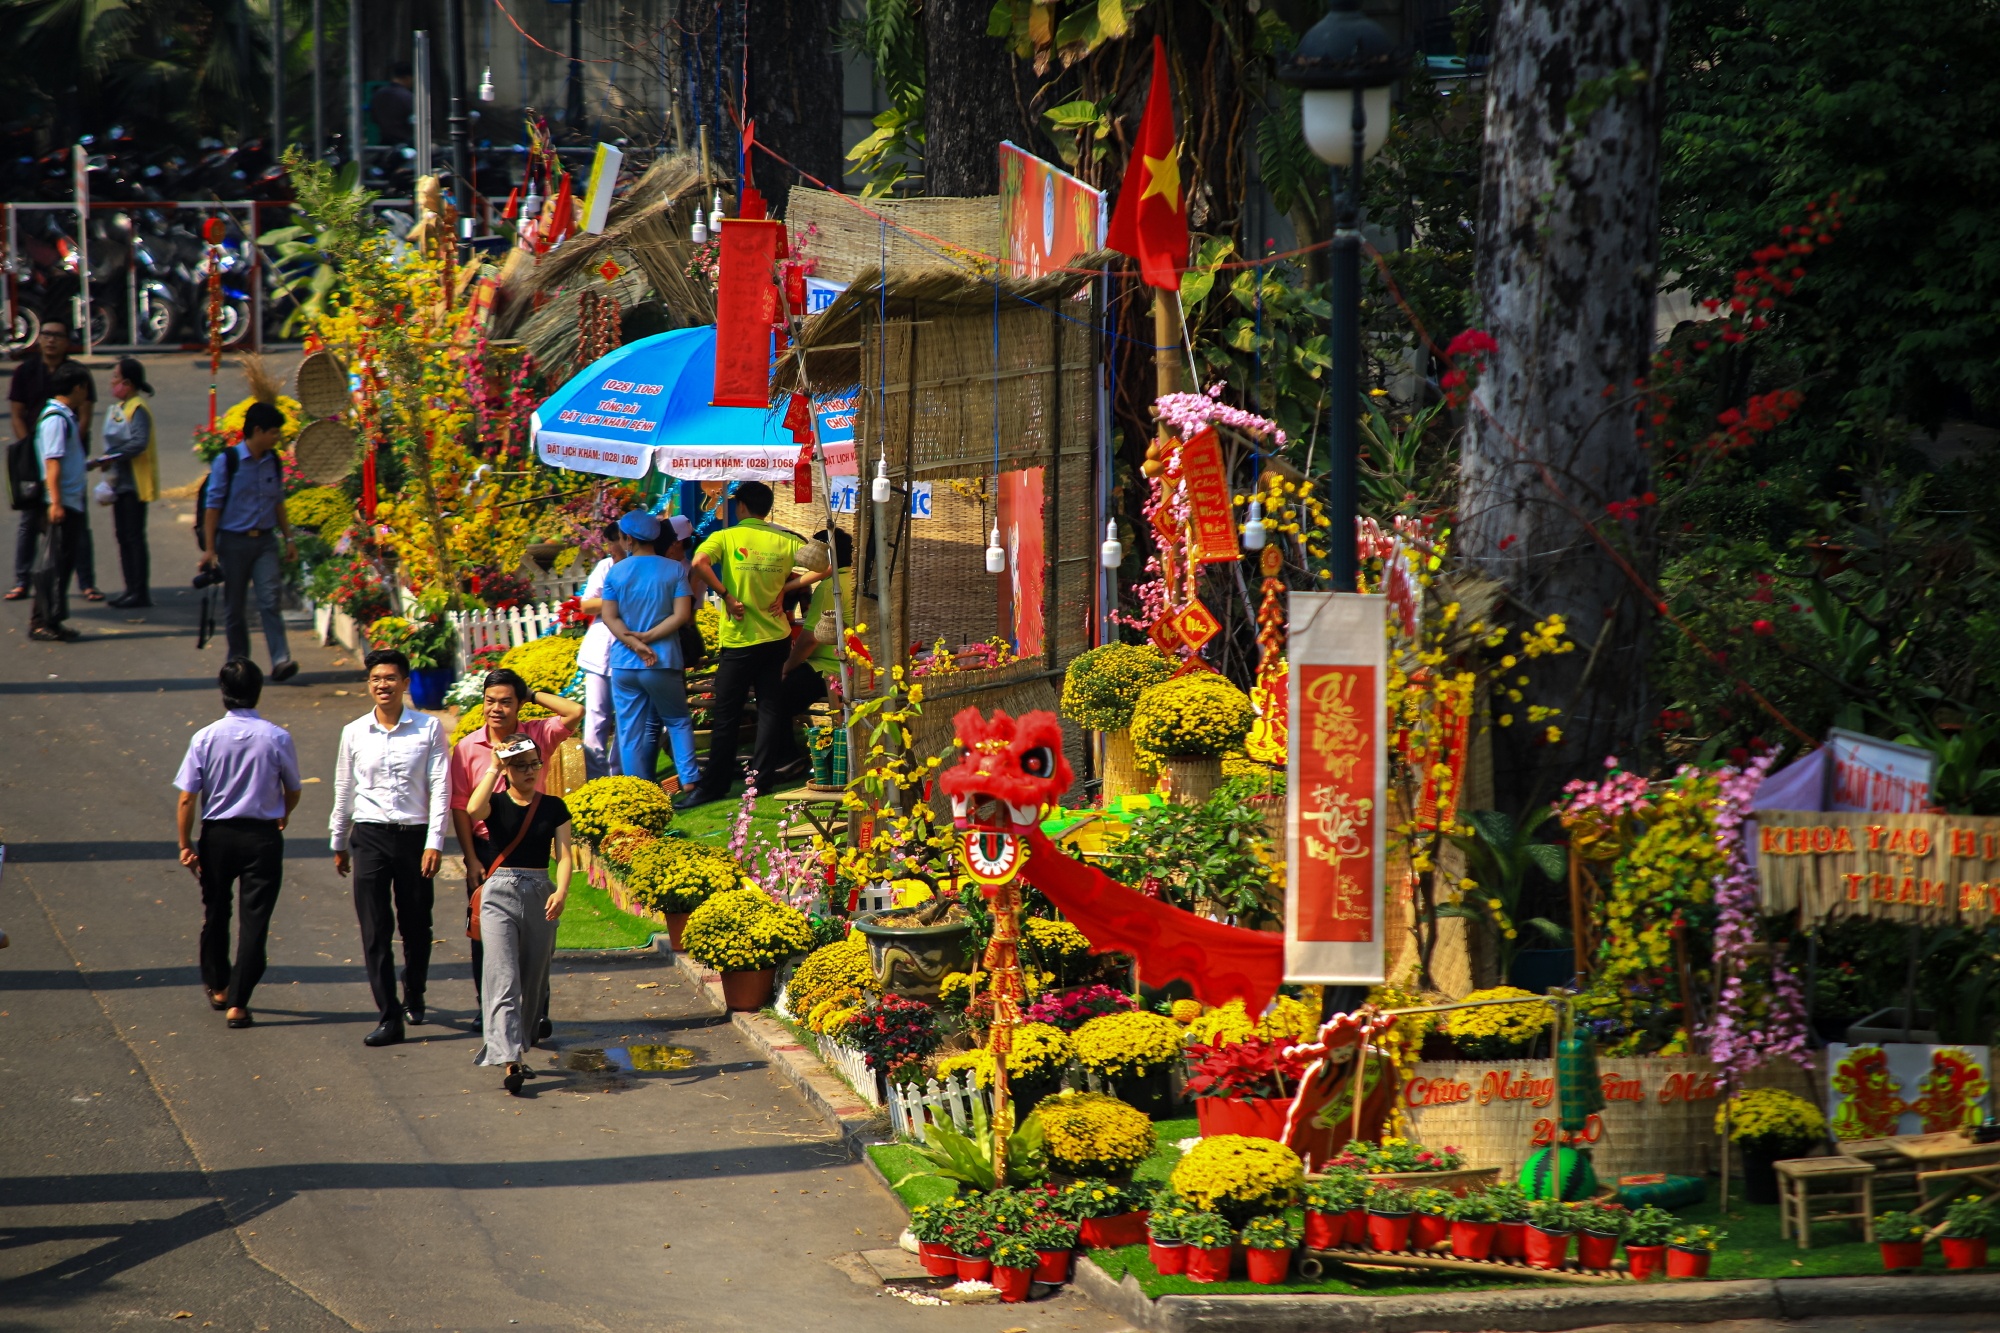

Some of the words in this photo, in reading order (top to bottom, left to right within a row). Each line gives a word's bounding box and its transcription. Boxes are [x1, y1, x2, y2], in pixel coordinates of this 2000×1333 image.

[602, 379, 633, 392] (028)
[634, 383, 663, 396] 1068
[596, 398, 620, 413] TỔNG
[621, 401, 641, 415] ĐÀI
[559, 409, 579, 423] ĐẶT
[579, 413, 602, 426] LỊCH
[602, 415, 631, 429] KHÁM
[629, 418, 657, 432] BỆNH
[547, 443, 560, 457] ĐẶT
[562, 445, 576, 457] LỊCH
[578, 446, 601, 460] KHÁM:
[602, 453, 620, 462] (028)
[621, 454, 639, 465] 1068
[672, 457, 690, 471] ĐẶT
[692, 458, 712, 470] LỊCH
[715, 456, 744, 468] KHÁM:
[746, 458, 769, 469] (028)
[772, 458, 794, 468] 1068
[1760, 825, 1853, 855] KHOA
[1404, 1077, 1471, 1107] Chúc
